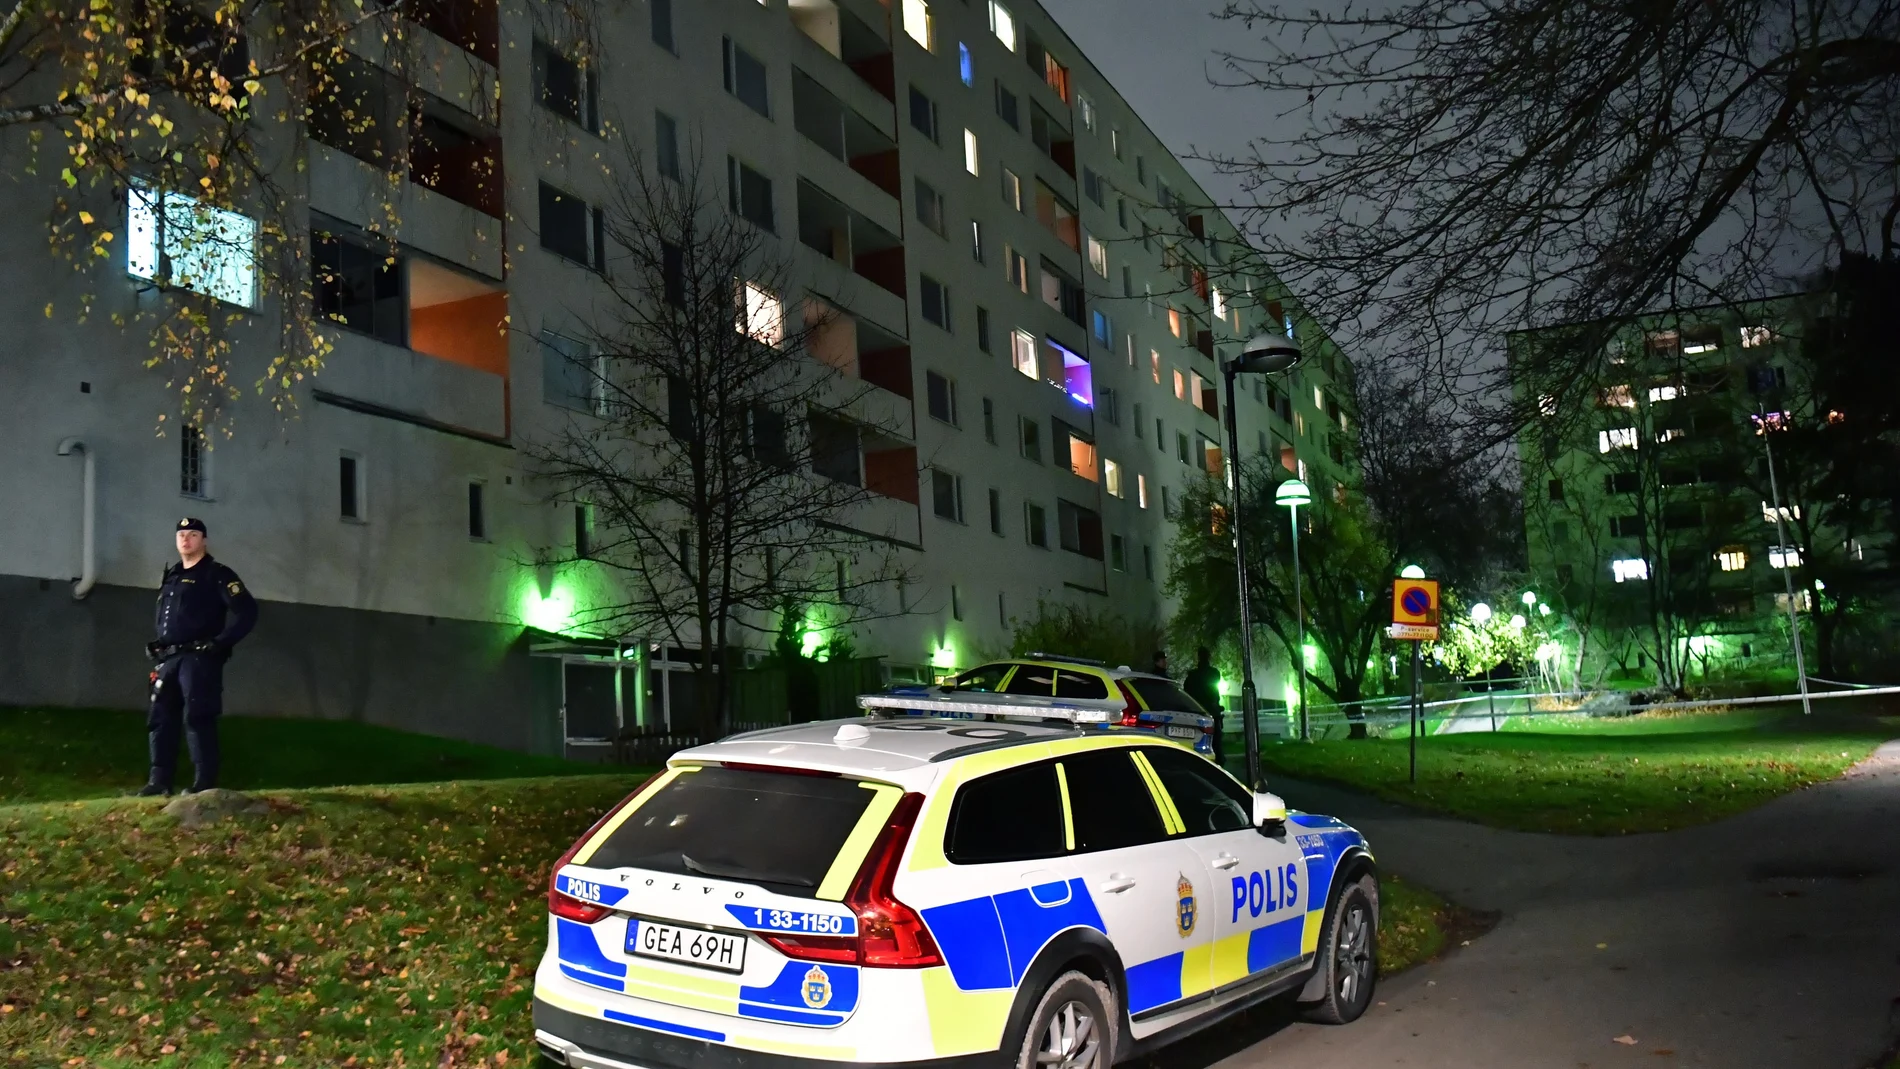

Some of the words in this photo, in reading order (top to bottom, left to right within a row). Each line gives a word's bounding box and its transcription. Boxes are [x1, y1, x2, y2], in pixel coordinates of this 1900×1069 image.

[567, 878, 600, 900] POLIS
[620, 874, 744, 899] VOLVO
[1231, 862, 1298, 923] POLIS
[754, 908, 762, 925] 1
[769, 910, 842, 934] 33-1150
[629, 938, 634, 946] S
[644, 926, 682, 955] GEA
[690, 934, 734, 964] 69H
